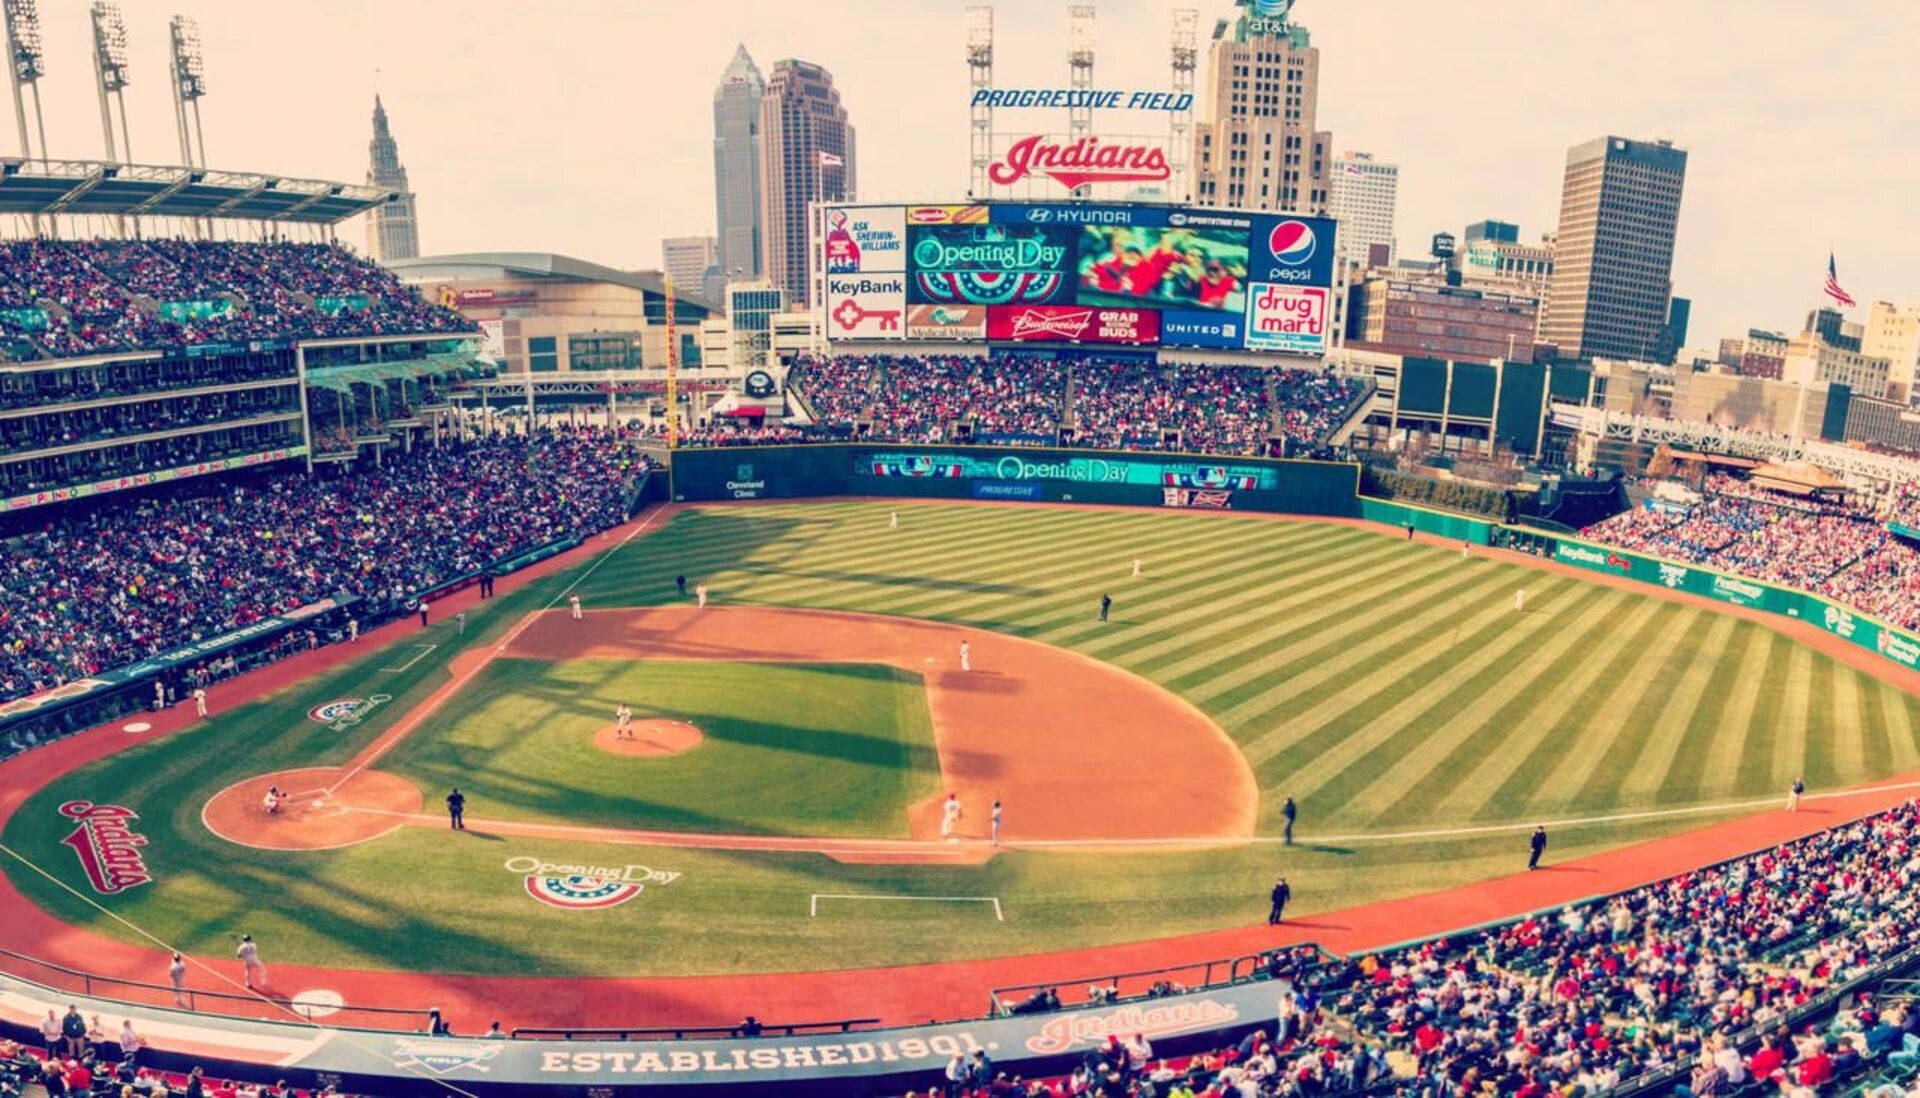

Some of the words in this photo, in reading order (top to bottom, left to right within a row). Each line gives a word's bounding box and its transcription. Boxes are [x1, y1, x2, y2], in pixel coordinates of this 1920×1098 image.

[1251, 17, 1289, 34] at&t
[971, 89, 1124, 108] PROGRESSIVE
[1128, 92, 1193, 111] FIELD
[989, 135, 1170, 188] Indians
[1056, 210, 1131, 223] HYUNDAI
[852, 222, 869, 231] ASK
[861, 240, 900, 251] WILLIAMS
[1269, 267, 1312, 281] pepsi
[830, 280, 903, 296] KeyBank
[1258, 286, 1312, 318] drug
[1011, 315, 1090, 332] Budweiser
[1099, 311, 1138, 322] GRAB
[1099, 328, 1138, 338] BUDS
[1166, 324, 1220, 334] UNITED
[1261, 317, 1322, 335] mart
[726, 480, 764, 489] Cleveland
[734, 490, 755, 498] Clinic
[58, 800, 154, 894] Indians
[1026, 1000, 1238, 1053] Indians
